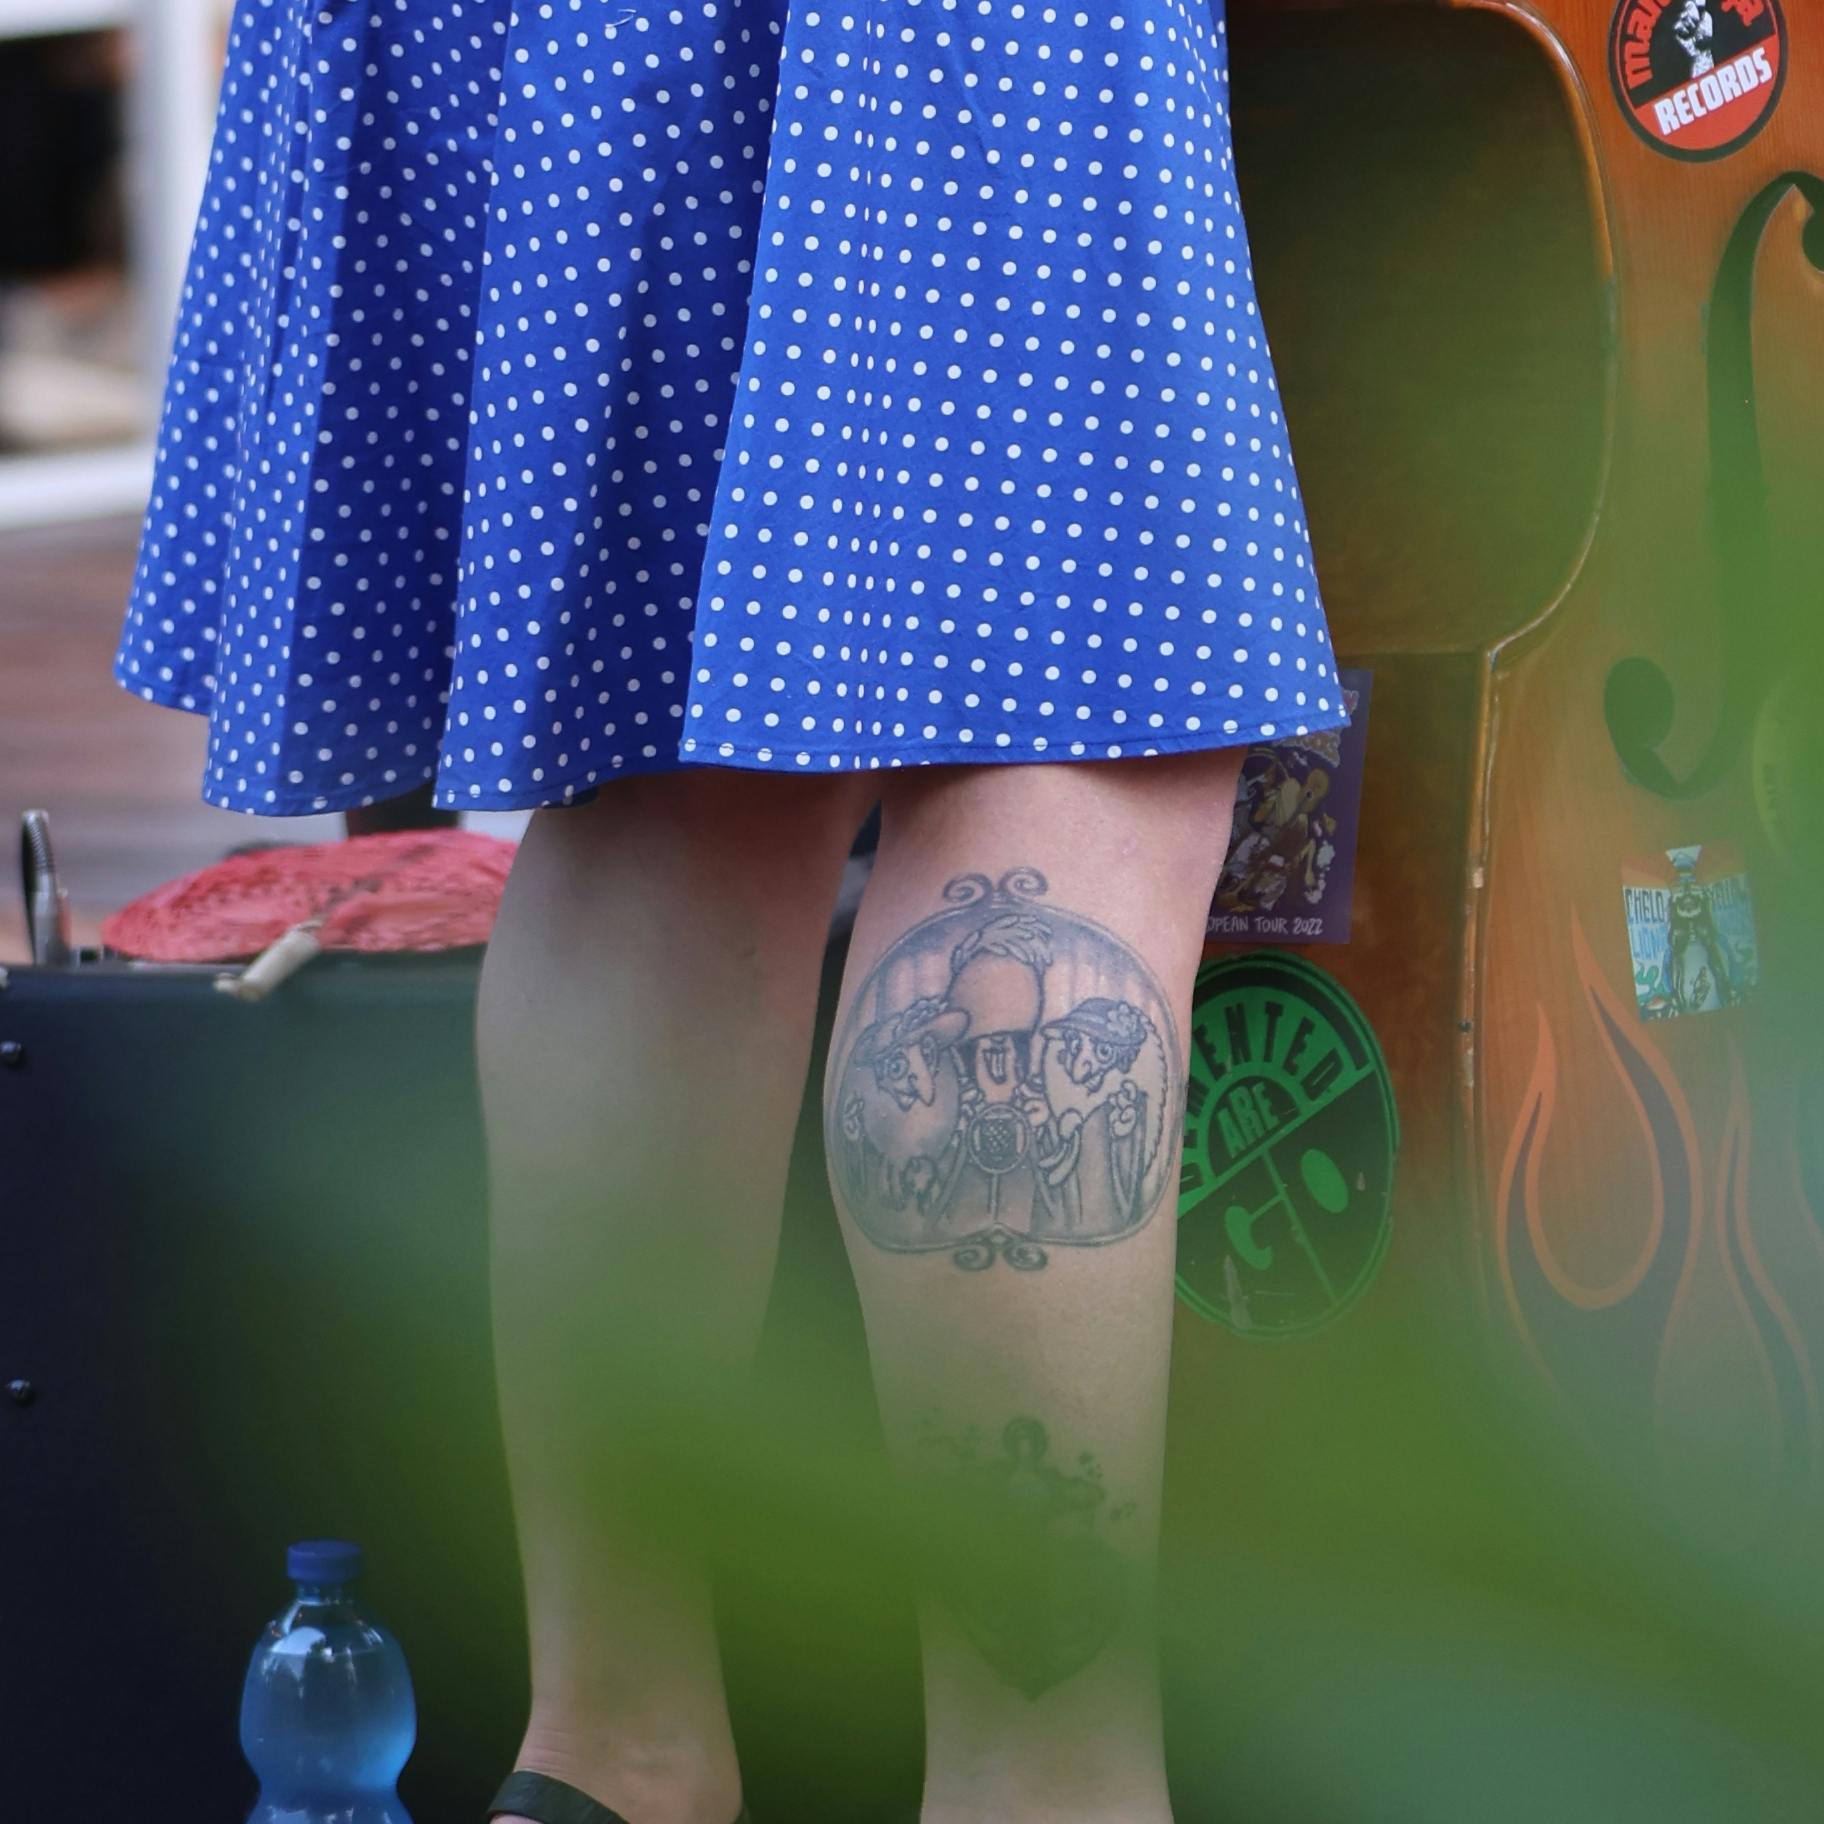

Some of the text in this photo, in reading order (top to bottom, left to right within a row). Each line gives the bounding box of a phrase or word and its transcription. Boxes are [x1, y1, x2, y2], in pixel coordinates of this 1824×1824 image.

[1654, 47, 1773, 136] RECORDS
[1207, 916, 1323, 936] OPEAN TOUR 2022
[1216, 1081, 1280, 1159] ARE
